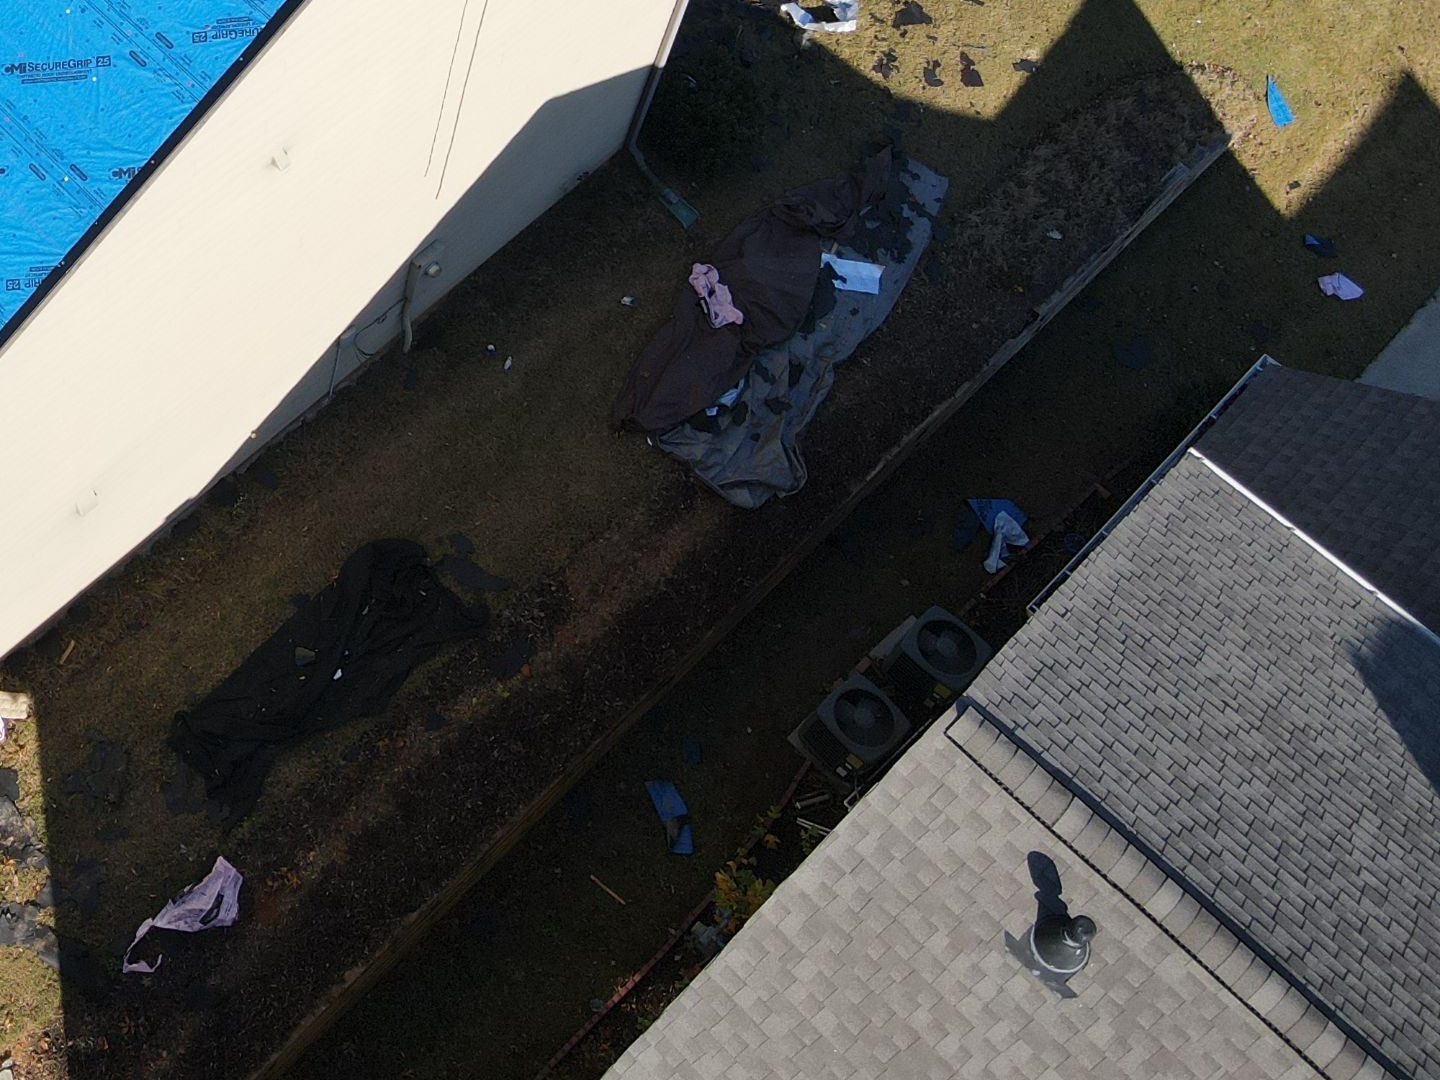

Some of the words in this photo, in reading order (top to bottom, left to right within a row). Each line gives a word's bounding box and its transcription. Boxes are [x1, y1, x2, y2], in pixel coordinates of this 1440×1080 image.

[191, 30, 207, 43] 25
[96, 56, 110, 66] 25
[5, 278, 20, 290] 25
